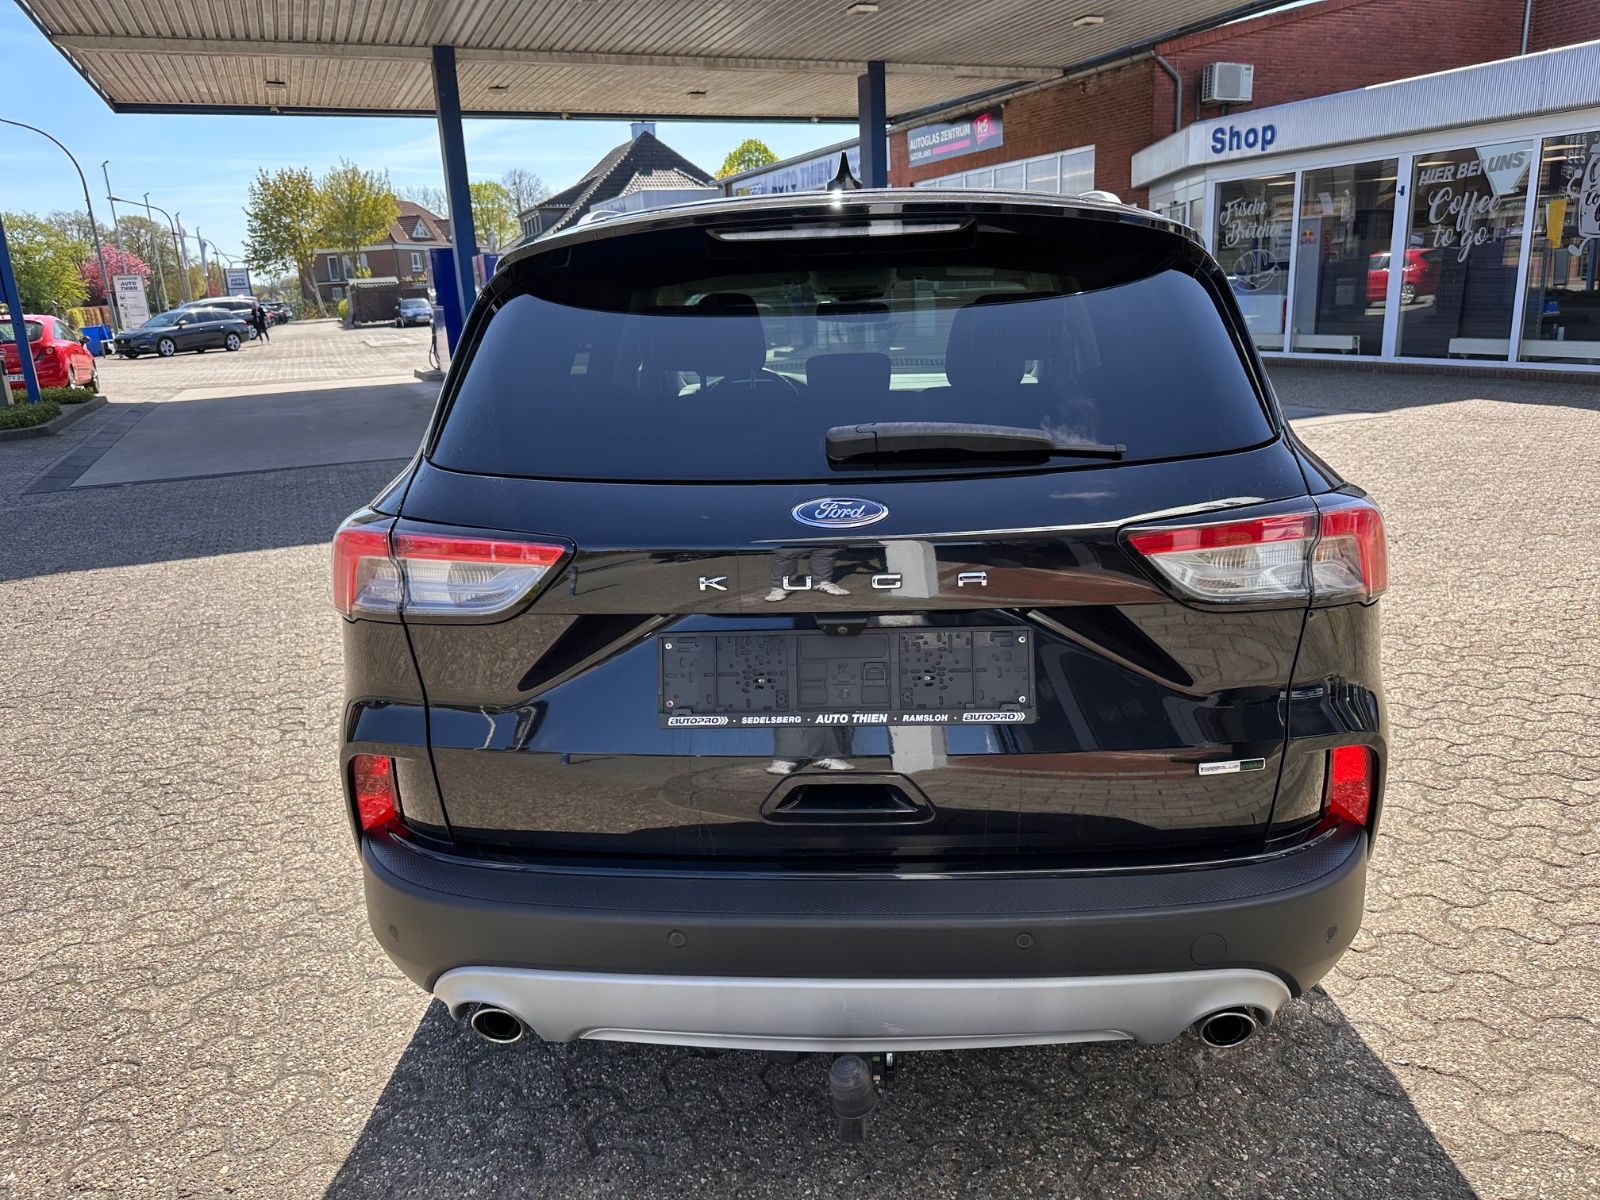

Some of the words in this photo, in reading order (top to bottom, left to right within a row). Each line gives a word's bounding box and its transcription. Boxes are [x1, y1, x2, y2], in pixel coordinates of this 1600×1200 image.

[910, 132, 940, 150] AUTOGLAS
[940, 123, 971, 142] ZENTRUM
[1211, 124, 1276, 154] Shop
[1418, 164, 1455, 186] HIER
[1456, 159, 1484, 180] BEI
[1488, 151, 1527, 173] UNS
[1220, 197, 1268, 225] Frische
[1428, 186, 1501, 232] Coffee
[1432, 223, 1456, 247] to
[1458, 226, 1490, 262] go
[815, 500, 866, 519] Ford
[699, 571, 988, 591] KUGA
[741, 716, 801, 724] SEDELSBERG
[815, 714, 848, 723] AUTO
[852, 714, 888, 723] THIEN
[902, 714, 948, 722] RAMSLOH
